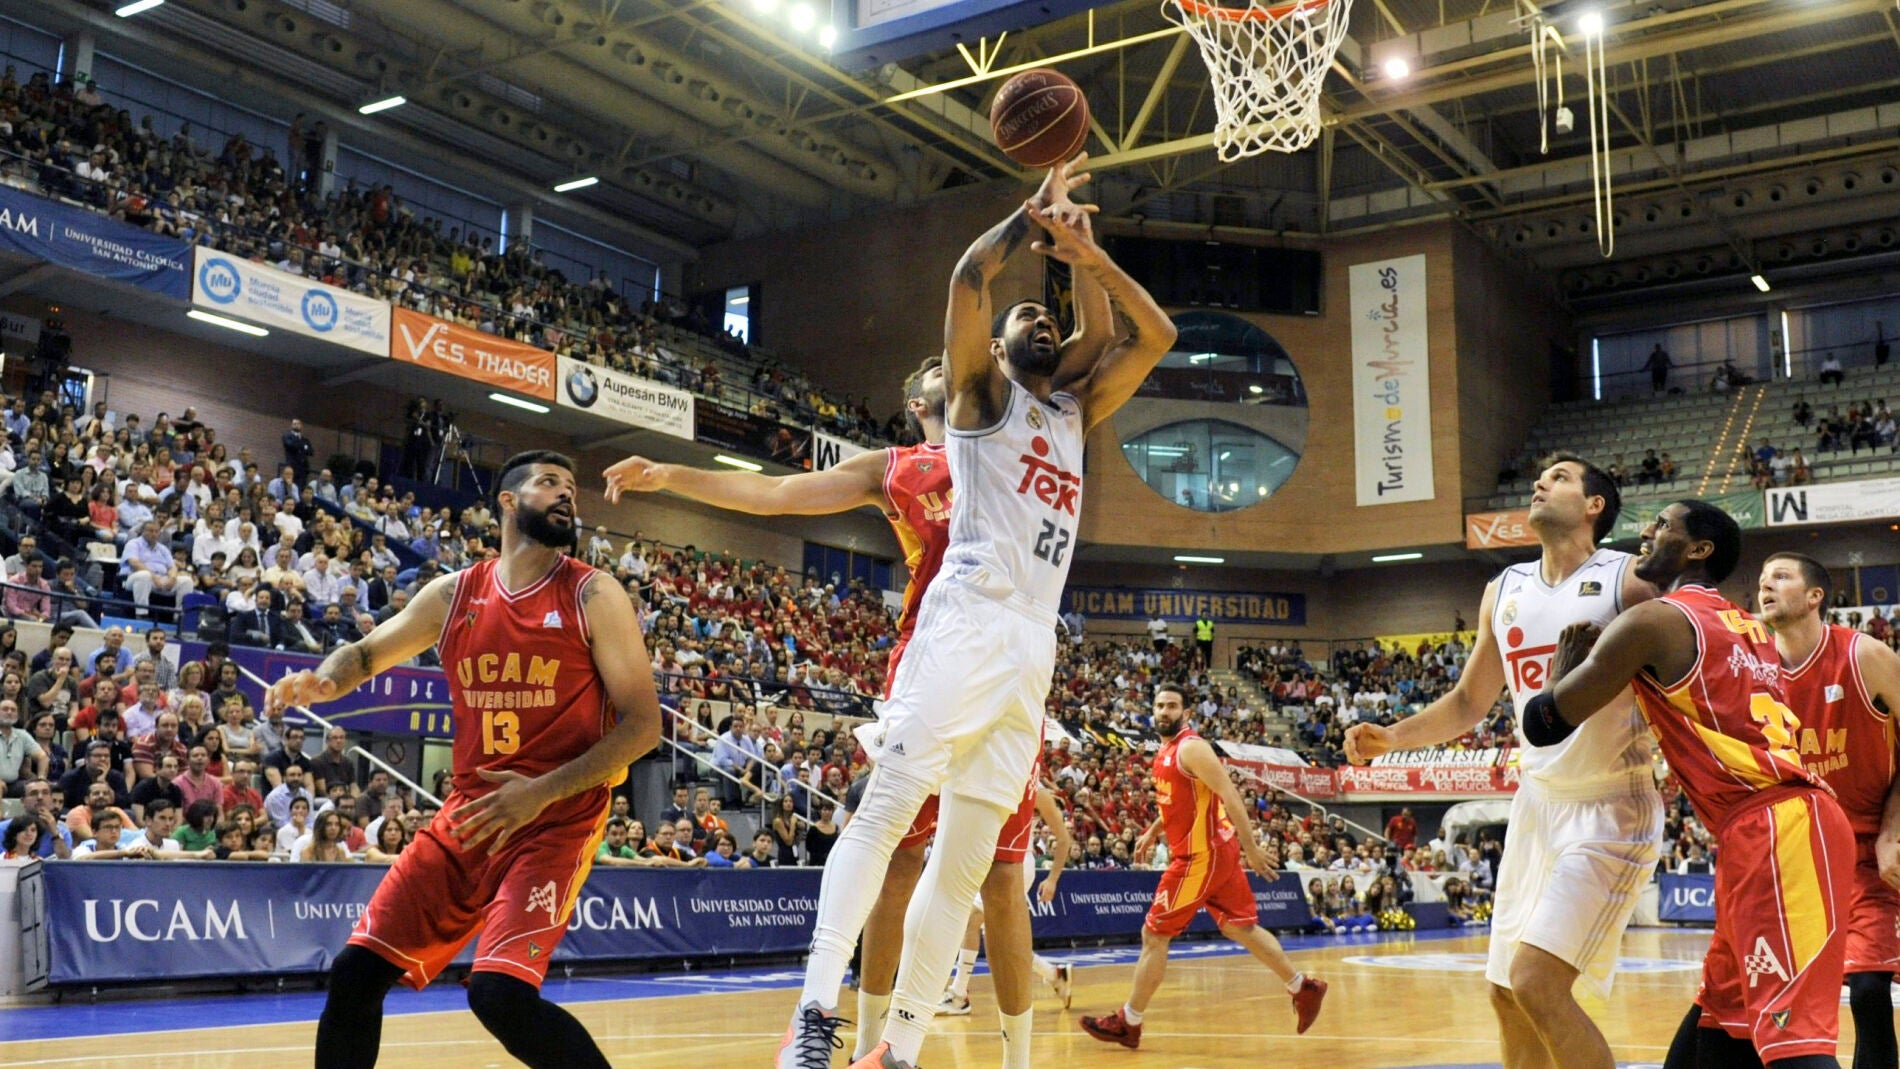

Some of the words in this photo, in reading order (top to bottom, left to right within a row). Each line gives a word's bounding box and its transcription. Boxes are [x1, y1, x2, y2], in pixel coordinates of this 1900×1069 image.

[65, 227, 133, 256] UNIVERSIDAD
[92, 246, 111, 259] SAN
[113, 253, 158, 271] ANTONIO
[210, 273, 232, 288] Mu
[310, 302, 330, 317] Mu
[475, 349, 550, 388] THADER
[603, 377, 656, 404] Aupesán
[658, 392, 689, 412] BMW
[1034, 517, 1070, 569] 22
[1071, 591, 1135, 614] UCAM
[1143, 592, 1290, 620] UNIVERSIDAD
[457, 652, 561, 689] UCAM
[482, 710, 520, 755] 13
[1339, 766, 1408, 789] Apuestas
[1359, 781, 1371, 790] de
[1420, 766, 1491, 790] Apuestas
[1440, 781, 1453, 790] de
[691, 896, 774, 914] UNIVERSIDAD
[1071, 891, 1122, 904] UNIVERSIDAD
[1095, 904, 1109, 915] SAN
[1111, 904, 1143, 914] ANTONIO
[84, 898, 248, 943] UCAM
[729, 913, 751, 928] SAN
[755, 913, 805, 927] ANTONIO
